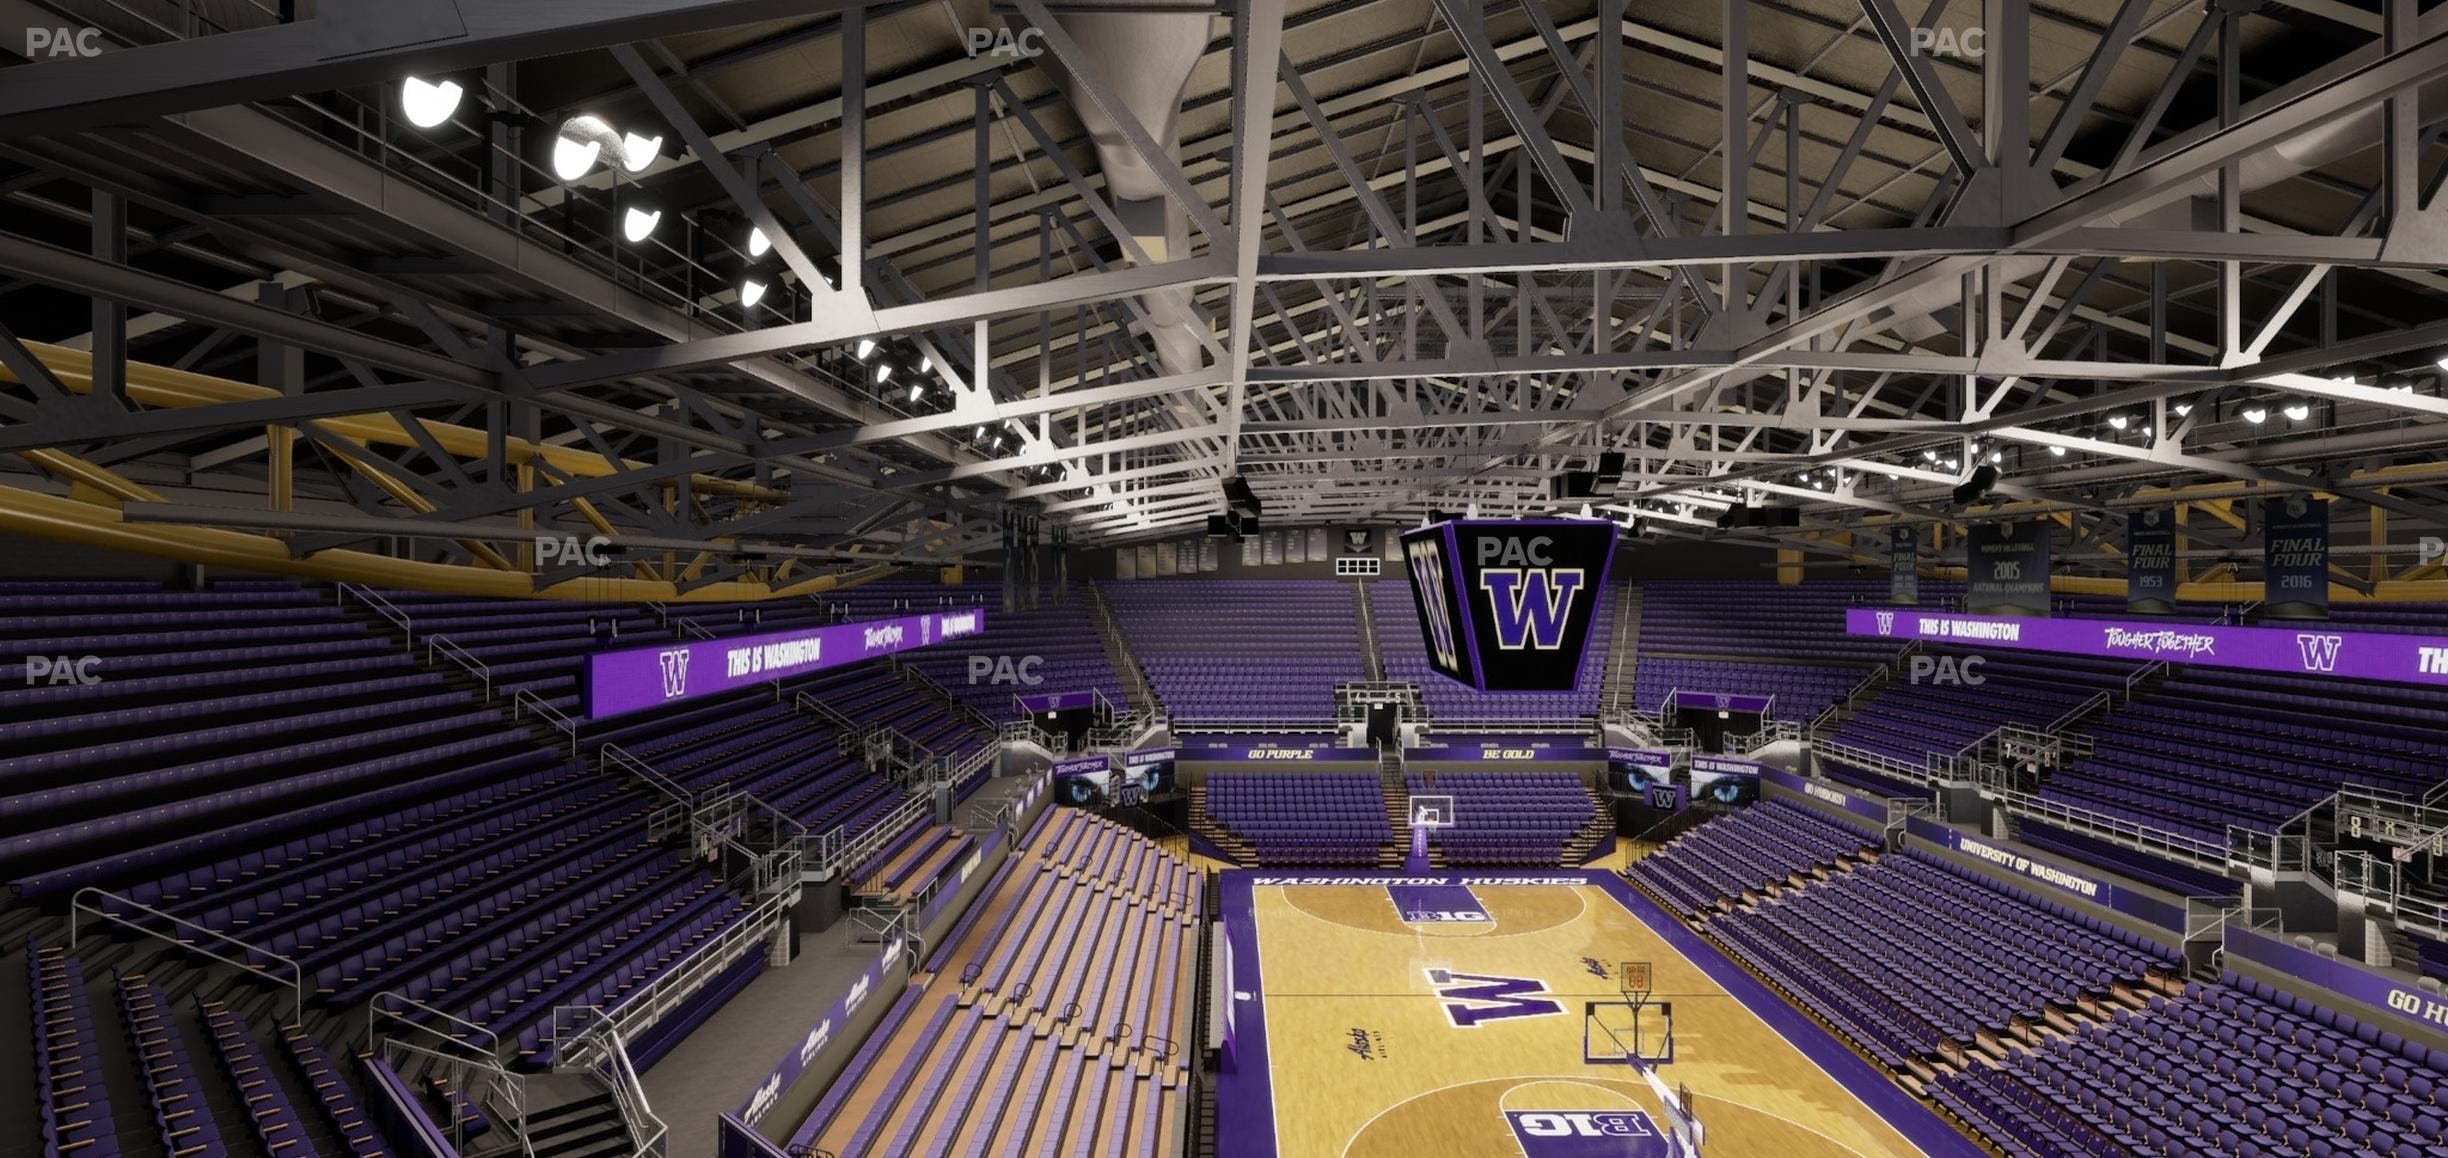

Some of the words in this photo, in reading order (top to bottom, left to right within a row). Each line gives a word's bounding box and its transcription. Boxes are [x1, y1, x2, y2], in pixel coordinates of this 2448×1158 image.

[2132, 543, 2173, 556] FINAL
[2270, 538, 2326, 553] FINAL
[2132, 556, 2170, 569] FOUR
[2272, 552, 2322, 568] FOUR
[1994, 561, 2020, 580] 2005
[2139, 575, 2162, 588] 1953
[2281, 575, 2312, 589] 2016
[1480, 568, 1585, 650] W
[1919, 618, 1938, 636] THIS
[1939, 620, 1950, 636] IS
[1951, 620, 2021, 642] WASHINGTON
[2104, 626, 2153, 651] TOUGHER
[2151, 631, 2215, 658] TOGETHER
[727, 647, 751, 678] THIS
[751, 645, 763, 673] IS
[764, 637, 821, 671] WASHINGTON
[2297, 634, 2342, 672] W
[660, 648, 689, 698] W
[1248, 750, 1264, 760] GO
[1266, 750, 1313, 760] PURPLE
[1483, 750, 1501, 760] BE
[1503, 750, 1535, 760] GOLD
[1716, 762, 1759, 774] WASHINGTON
[1653, 788, 1677, 809] W
[1960, 838, 2014, 868] UNIVERSITY
[2015, 859, 2030, 873] OF
[2030, 862, 2098, 897] WASHINGTON
[1253, 877, 1449, 886] WASHINGTON
[1459, 877, 1588, 886] HUSKIES
[1422, 968, 1569, 1029] W
[2387, 988, 2421, 1015] GO
